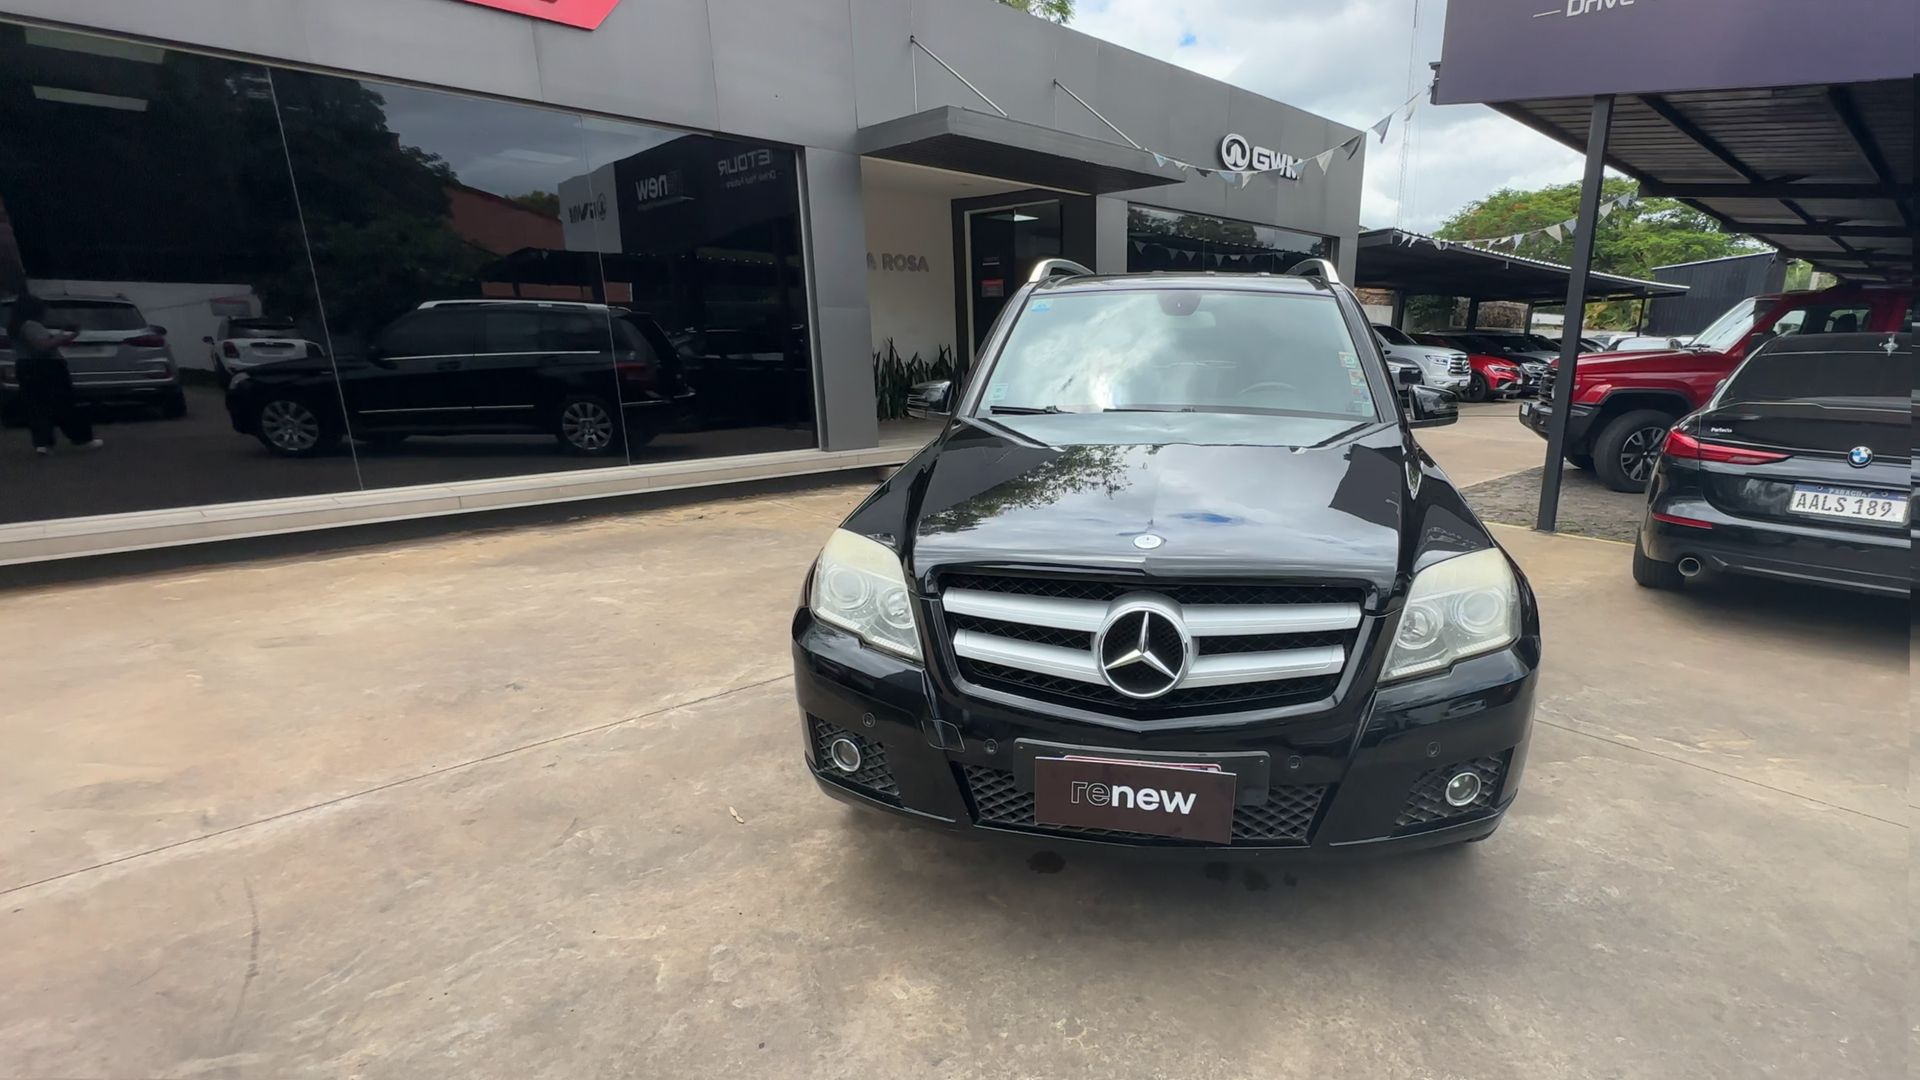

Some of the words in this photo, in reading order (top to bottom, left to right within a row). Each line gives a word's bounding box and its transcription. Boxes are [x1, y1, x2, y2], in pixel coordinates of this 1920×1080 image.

[1252, 146, 1301, 180] GWM
[881, 253, 930, 272] ROSA
[1796, 493, 1847, 512] AALS
[1852, 499, 1892, 517] 189
[1070, 780, 1197, 815] renew
